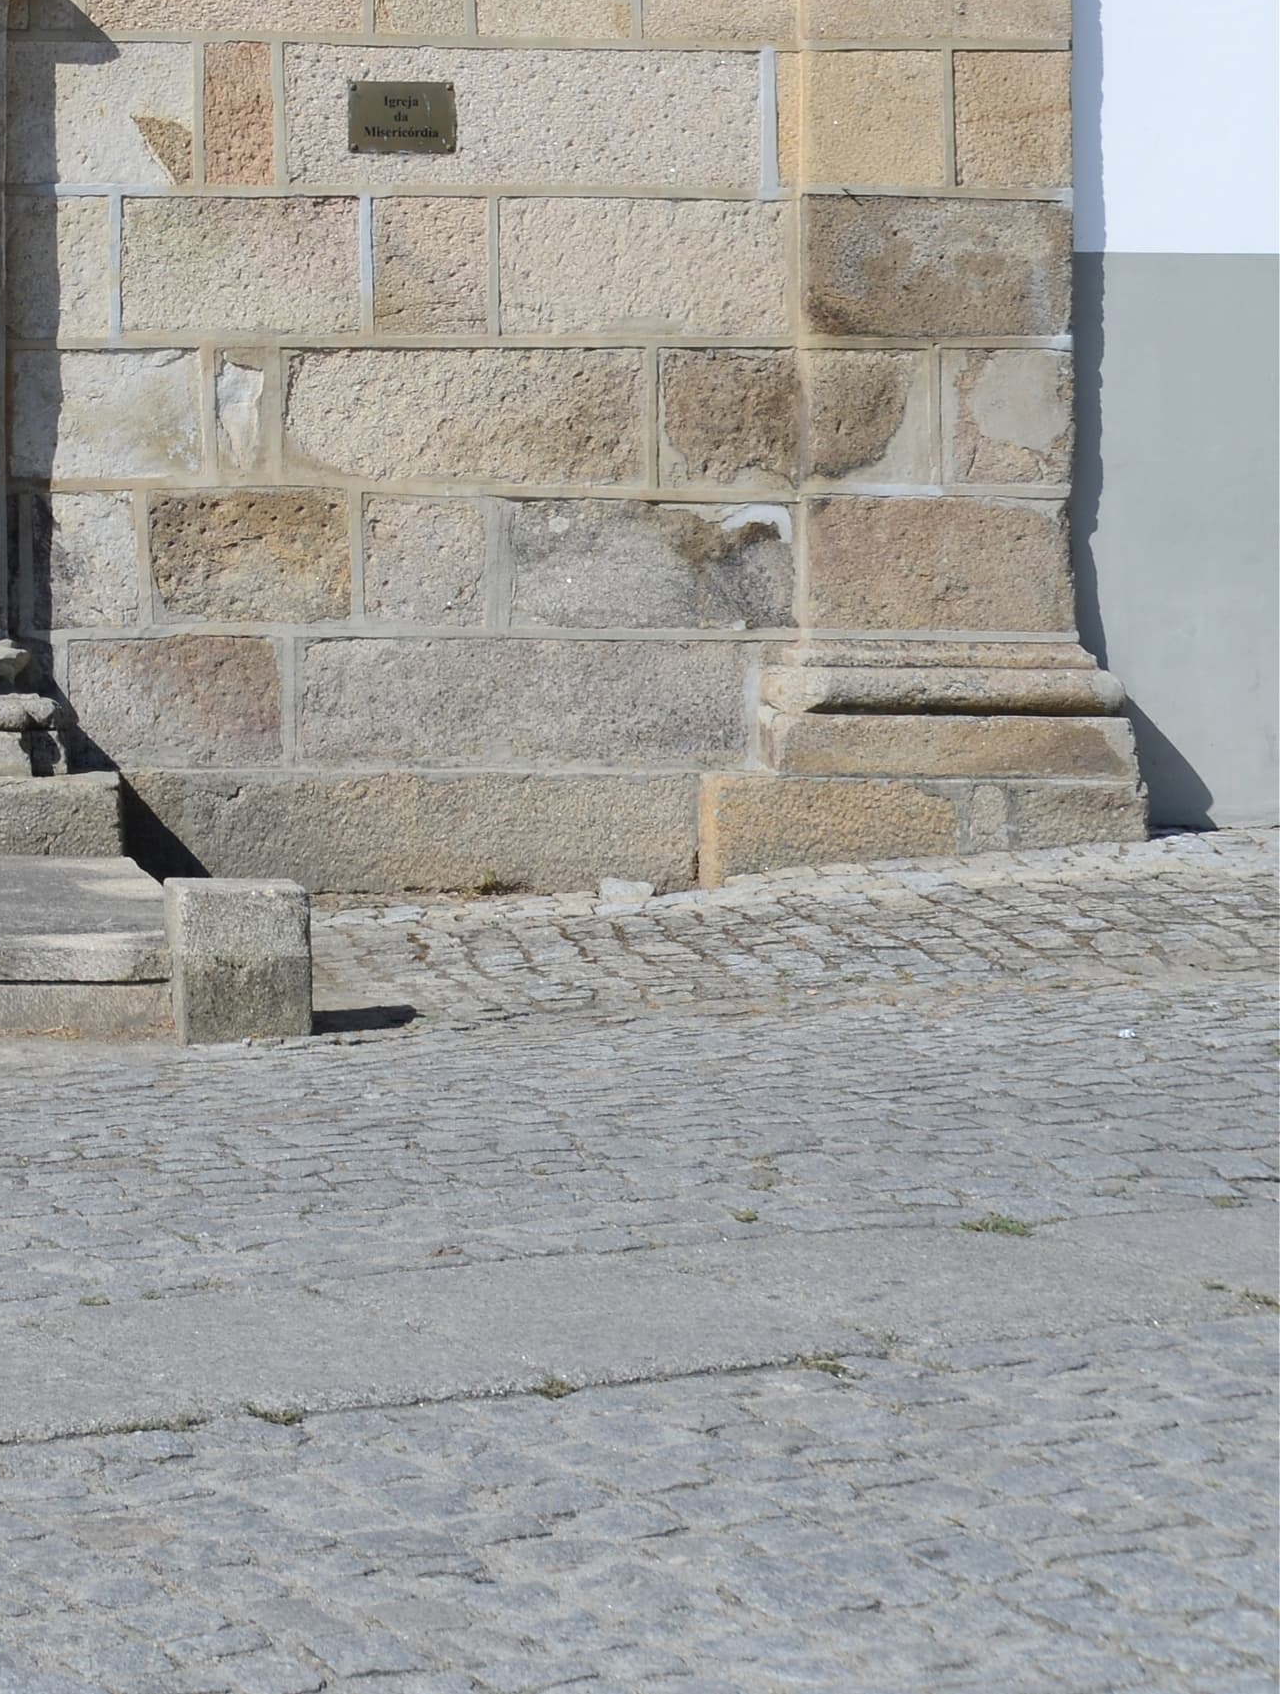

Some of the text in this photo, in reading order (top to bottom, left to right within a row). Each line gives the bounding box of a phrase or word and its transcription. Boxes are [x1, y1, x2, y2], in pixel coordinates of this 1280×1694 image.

[384, 95, 419, 110] Igreja
[394, 112, 408, 122] da
[364, 126, 439, 138] Misericórdia
